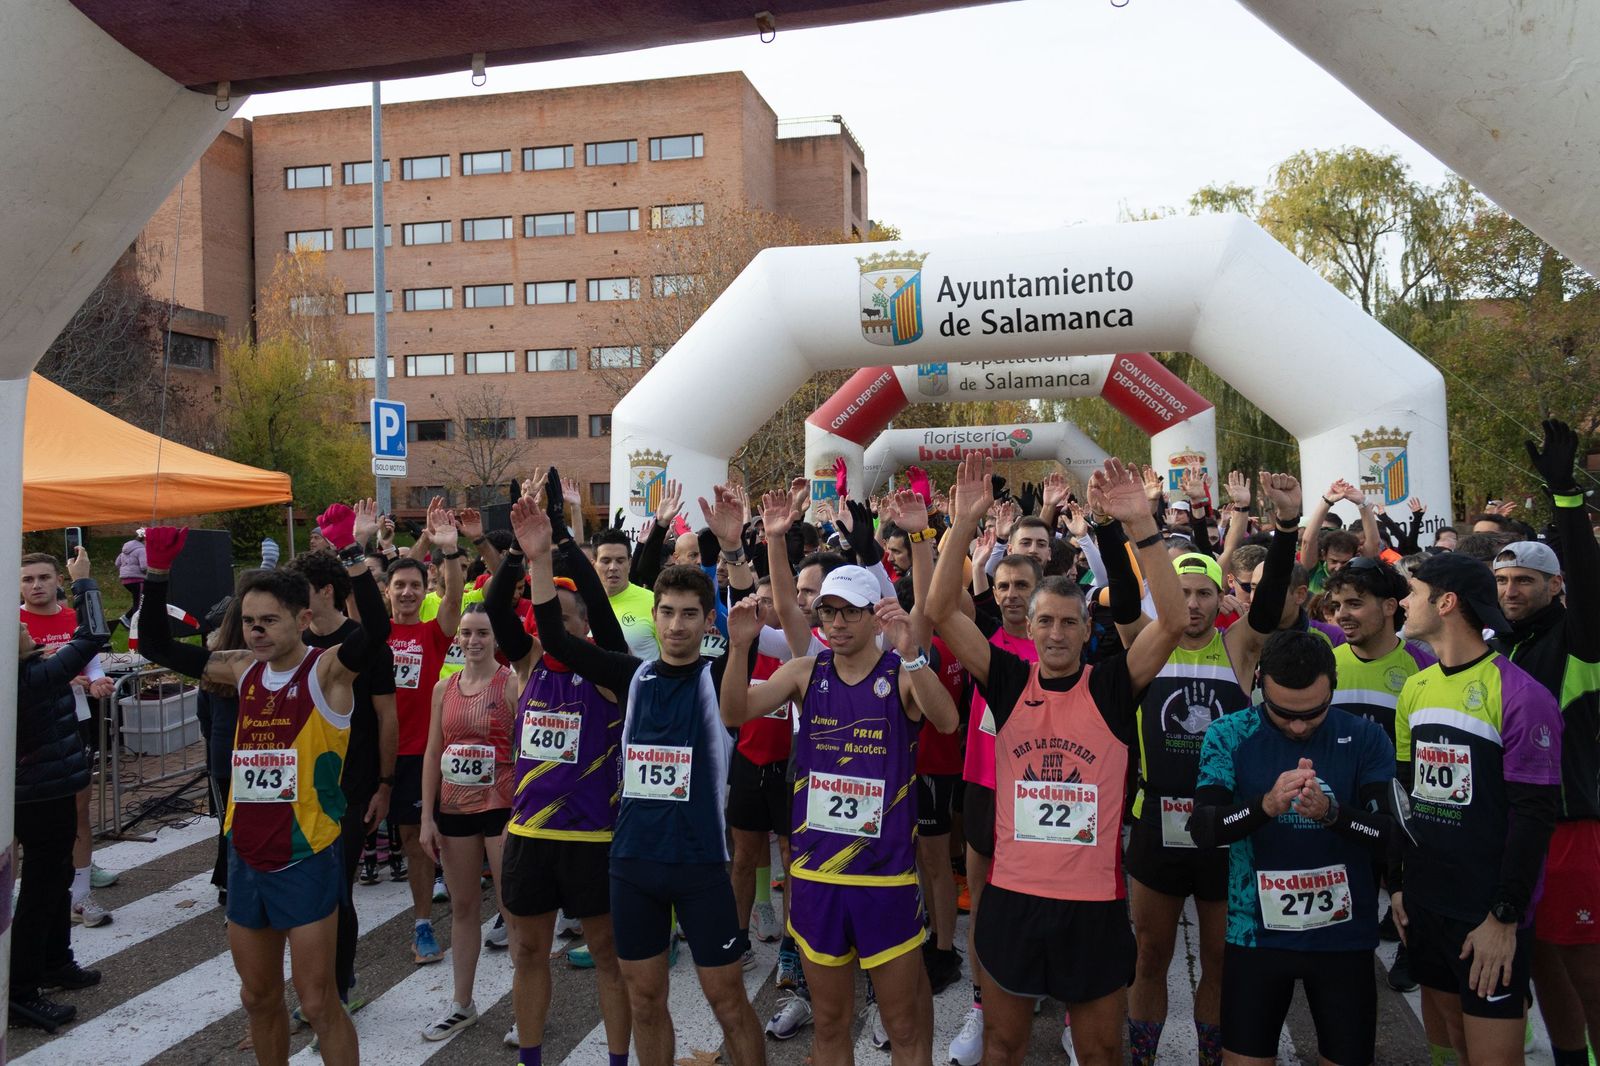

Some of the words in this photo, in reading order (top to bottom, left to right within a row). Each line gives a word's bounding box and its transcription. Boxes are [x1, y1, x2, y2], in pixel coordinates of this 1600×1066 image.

[936, 266, 1134, 309] Ayuntamiento
[939, 311, 971, 337] de
[981, 307, 1134, 335] Salamanca
[960, 377, 977, 391] de
[985, 372, 1091, 390] Salamanca
[1119, 358, 1142, 378] CON
[1139, 373, 1188, 414] NUESTROS
[831, 411, 850, 430] CON
[846, 403, 860, 416] EL
[855, 371, 892, 407] DEPORTE
[1112, 371, 1174, 421] DEPORTISTAS
[379, 406, 400, 451] P
[924, 429, 1008, 445] floristería
[390, 464, 406, 472] MOTOS
[525, 715, 579, 729] bedunia
[810, 715, 838, 726] Jamón
[530, 729, 566, 749] 480
[853, 728, 883, 739] PRIM
[627, 747, 691, 764] bedunia
[844, 742, 887, 754] Macotera
[1013, 741, 1033, 759] BAR
[1034, 739, 1048, 749] LA
[233, 752, 296, 767] bedunia
[451, 758, 483, 776] 348
[1042, 754, 1063, 768] RUN
[244, 769, 283, 790] 943
[638, 764, 677, 786] 153
[1041, 769, 1063, 782] CLUB
[1419, 762, 1454, 789] 940
[810, 775, 883, 798] bedunia
[1016, 783, 1096, 803] bedunia
[828, 795, 859, 819] 23
[1038, 803, 1071, 828] 22
[1223, 807, 1250, 825] KIPRUN
[1350, 820, 1380, 838] KIPRUN
[1259, 870, 1347, 891] bedunia
[1279, 889, 1335, 917] 273
